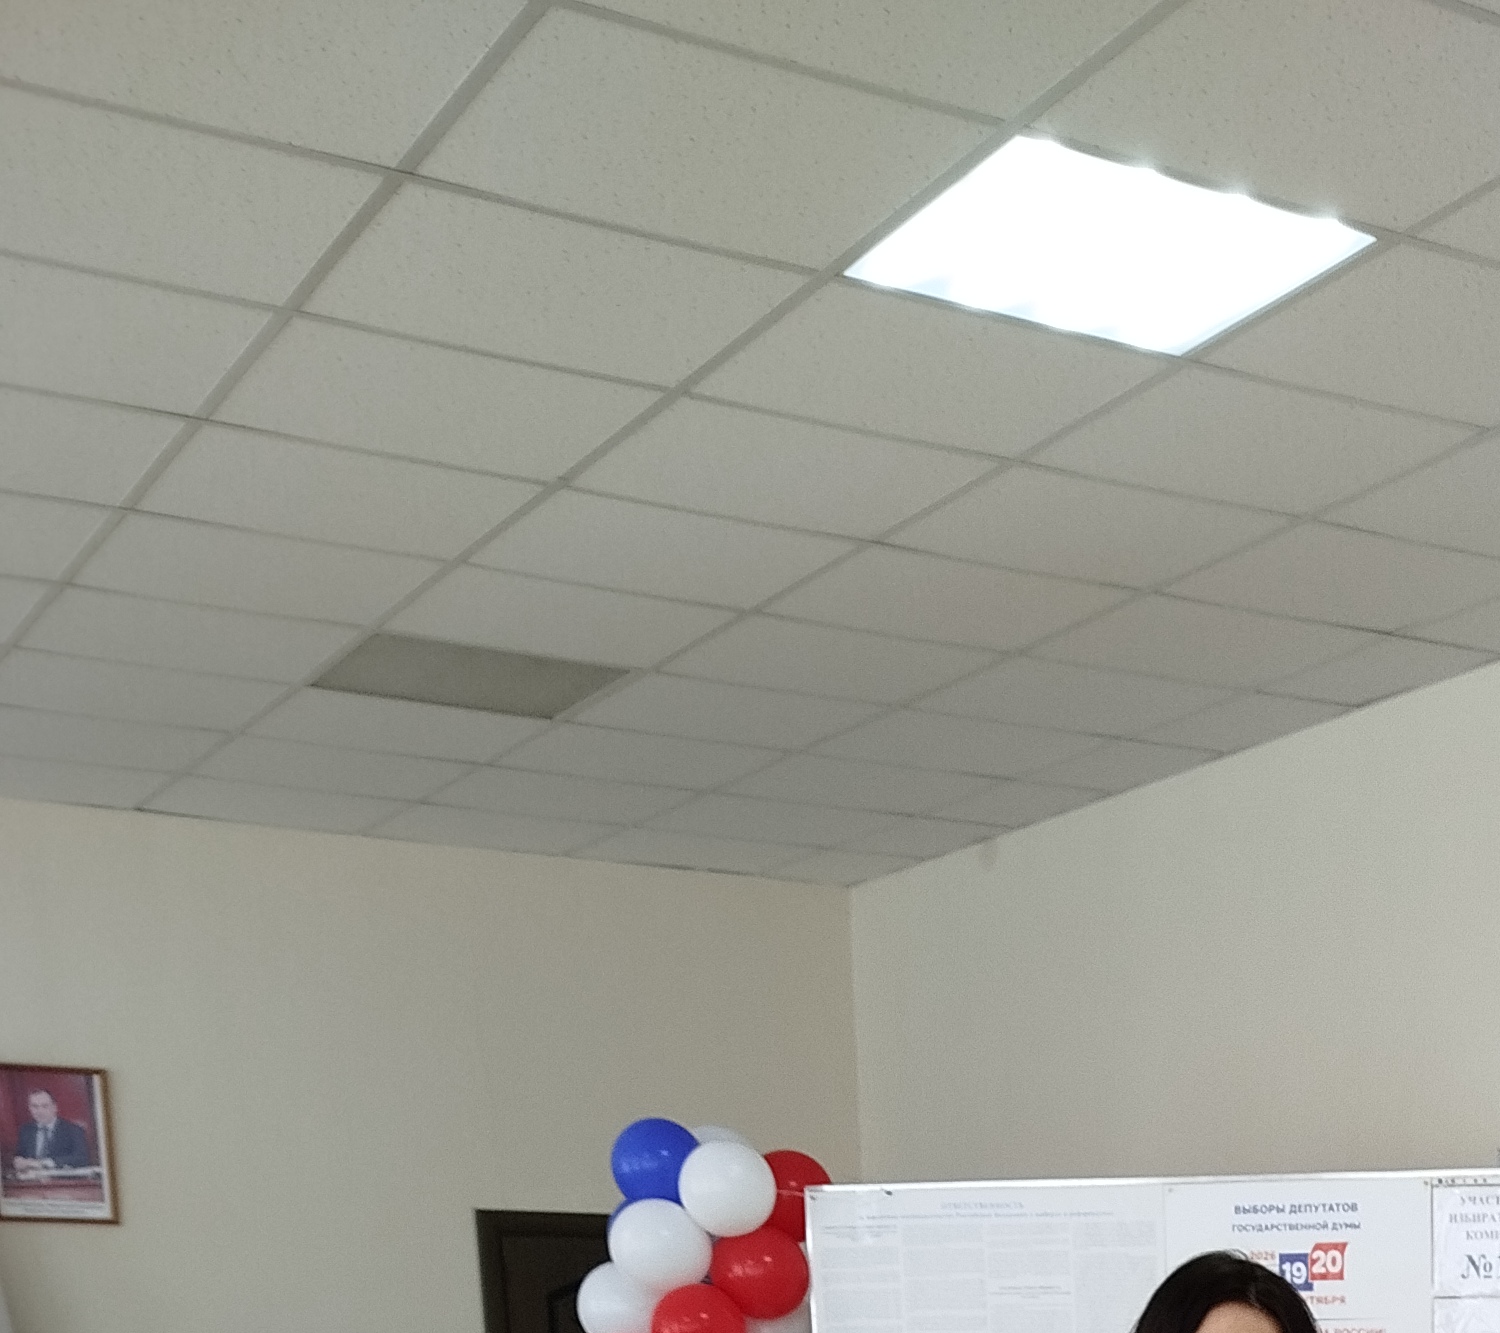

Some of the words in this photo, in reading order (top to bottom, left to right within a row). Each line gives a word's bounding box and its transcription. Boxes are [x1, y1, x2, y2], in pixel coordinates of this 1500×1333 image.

[1234, 1204, 1286, 1215] ВЫБОРЫ
[1289, 1203, 1359, 1214] ДЕПУТАТОВ
[1232, 1221, 1328, 1232] ГОСУДАРСТВЕННОЙ
[1331, 1222, 1361, 1231] ДУМЫ
[1282, 1261, 1307, 1284] 19
[1312, 1250, 1343, 1274] 20
[1308, 1295, 1346, 1305] ТЯБРЯ
